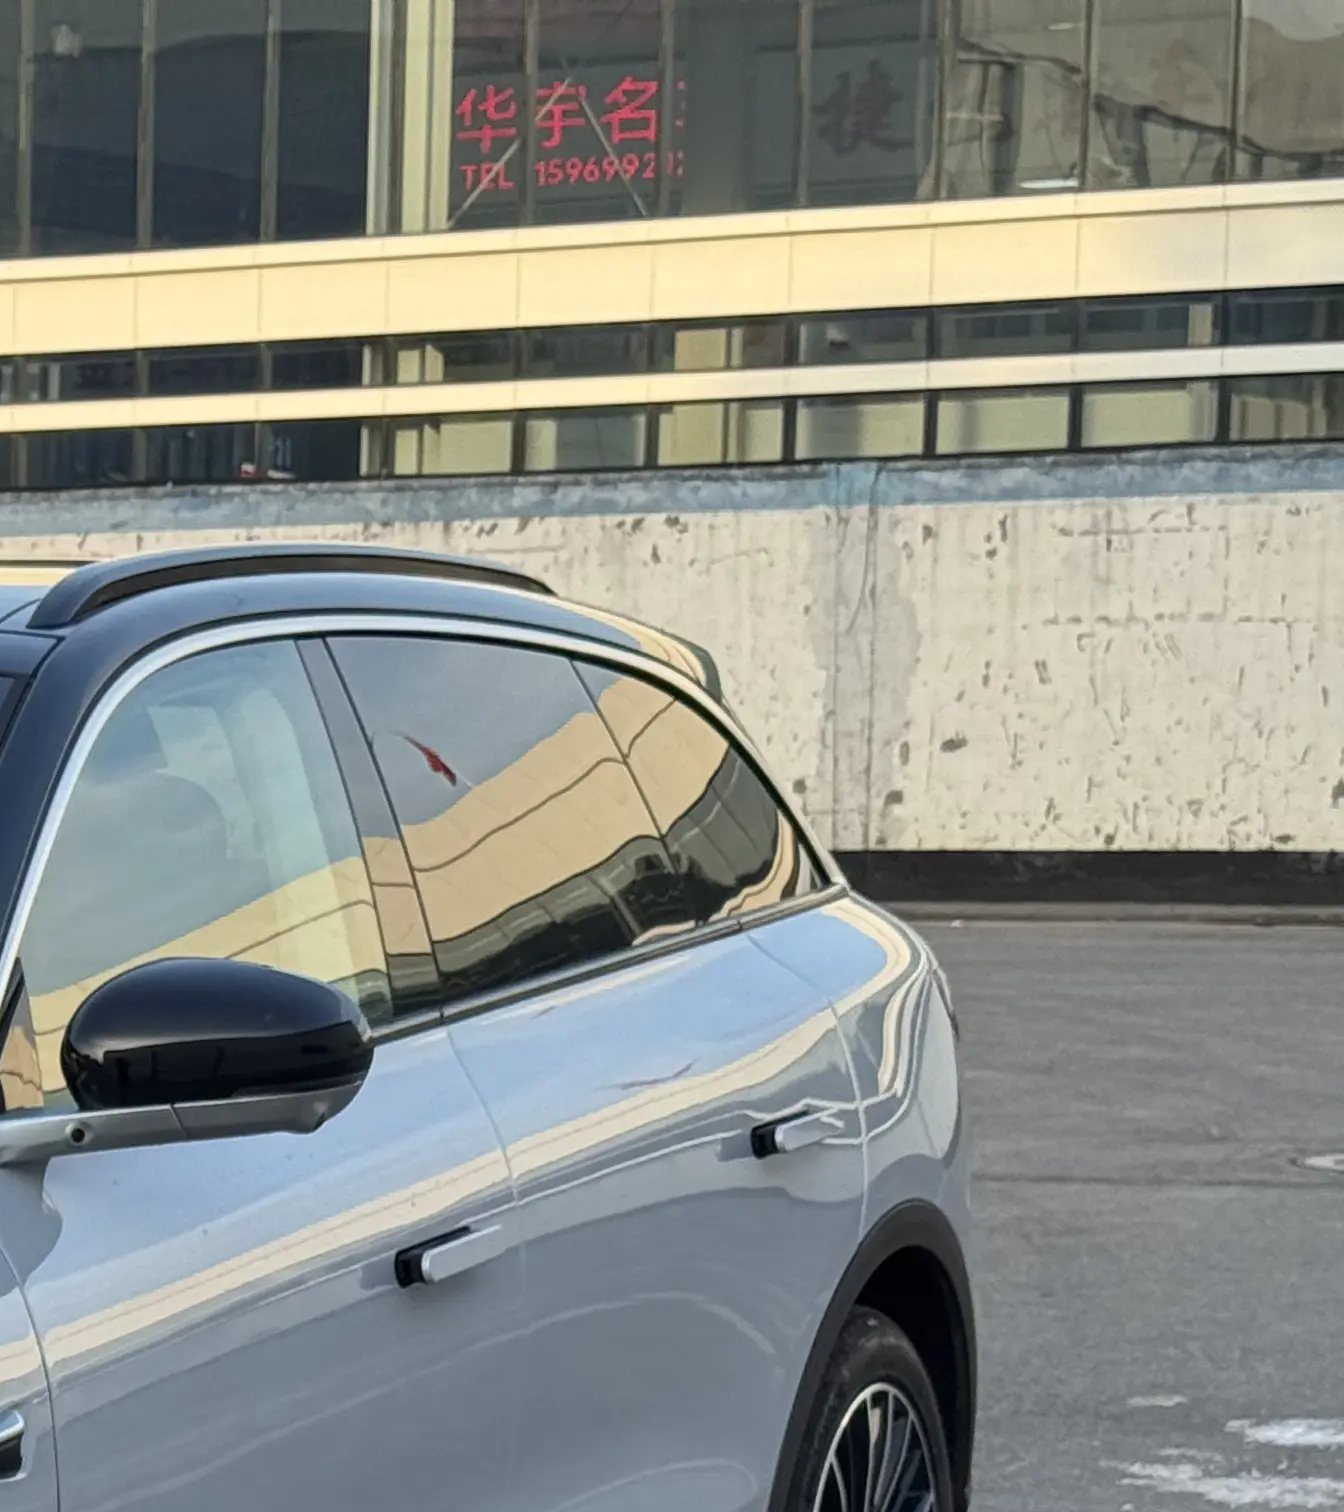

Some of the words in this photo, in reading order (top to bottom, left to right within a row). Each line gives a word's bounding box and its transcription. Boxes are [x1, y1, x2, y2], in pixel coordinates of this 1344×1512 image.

[455, 76, 685, 154] 华宇名
[460, 163, 514, 191] TEL
[533, 151, 684, 187] 1596992
